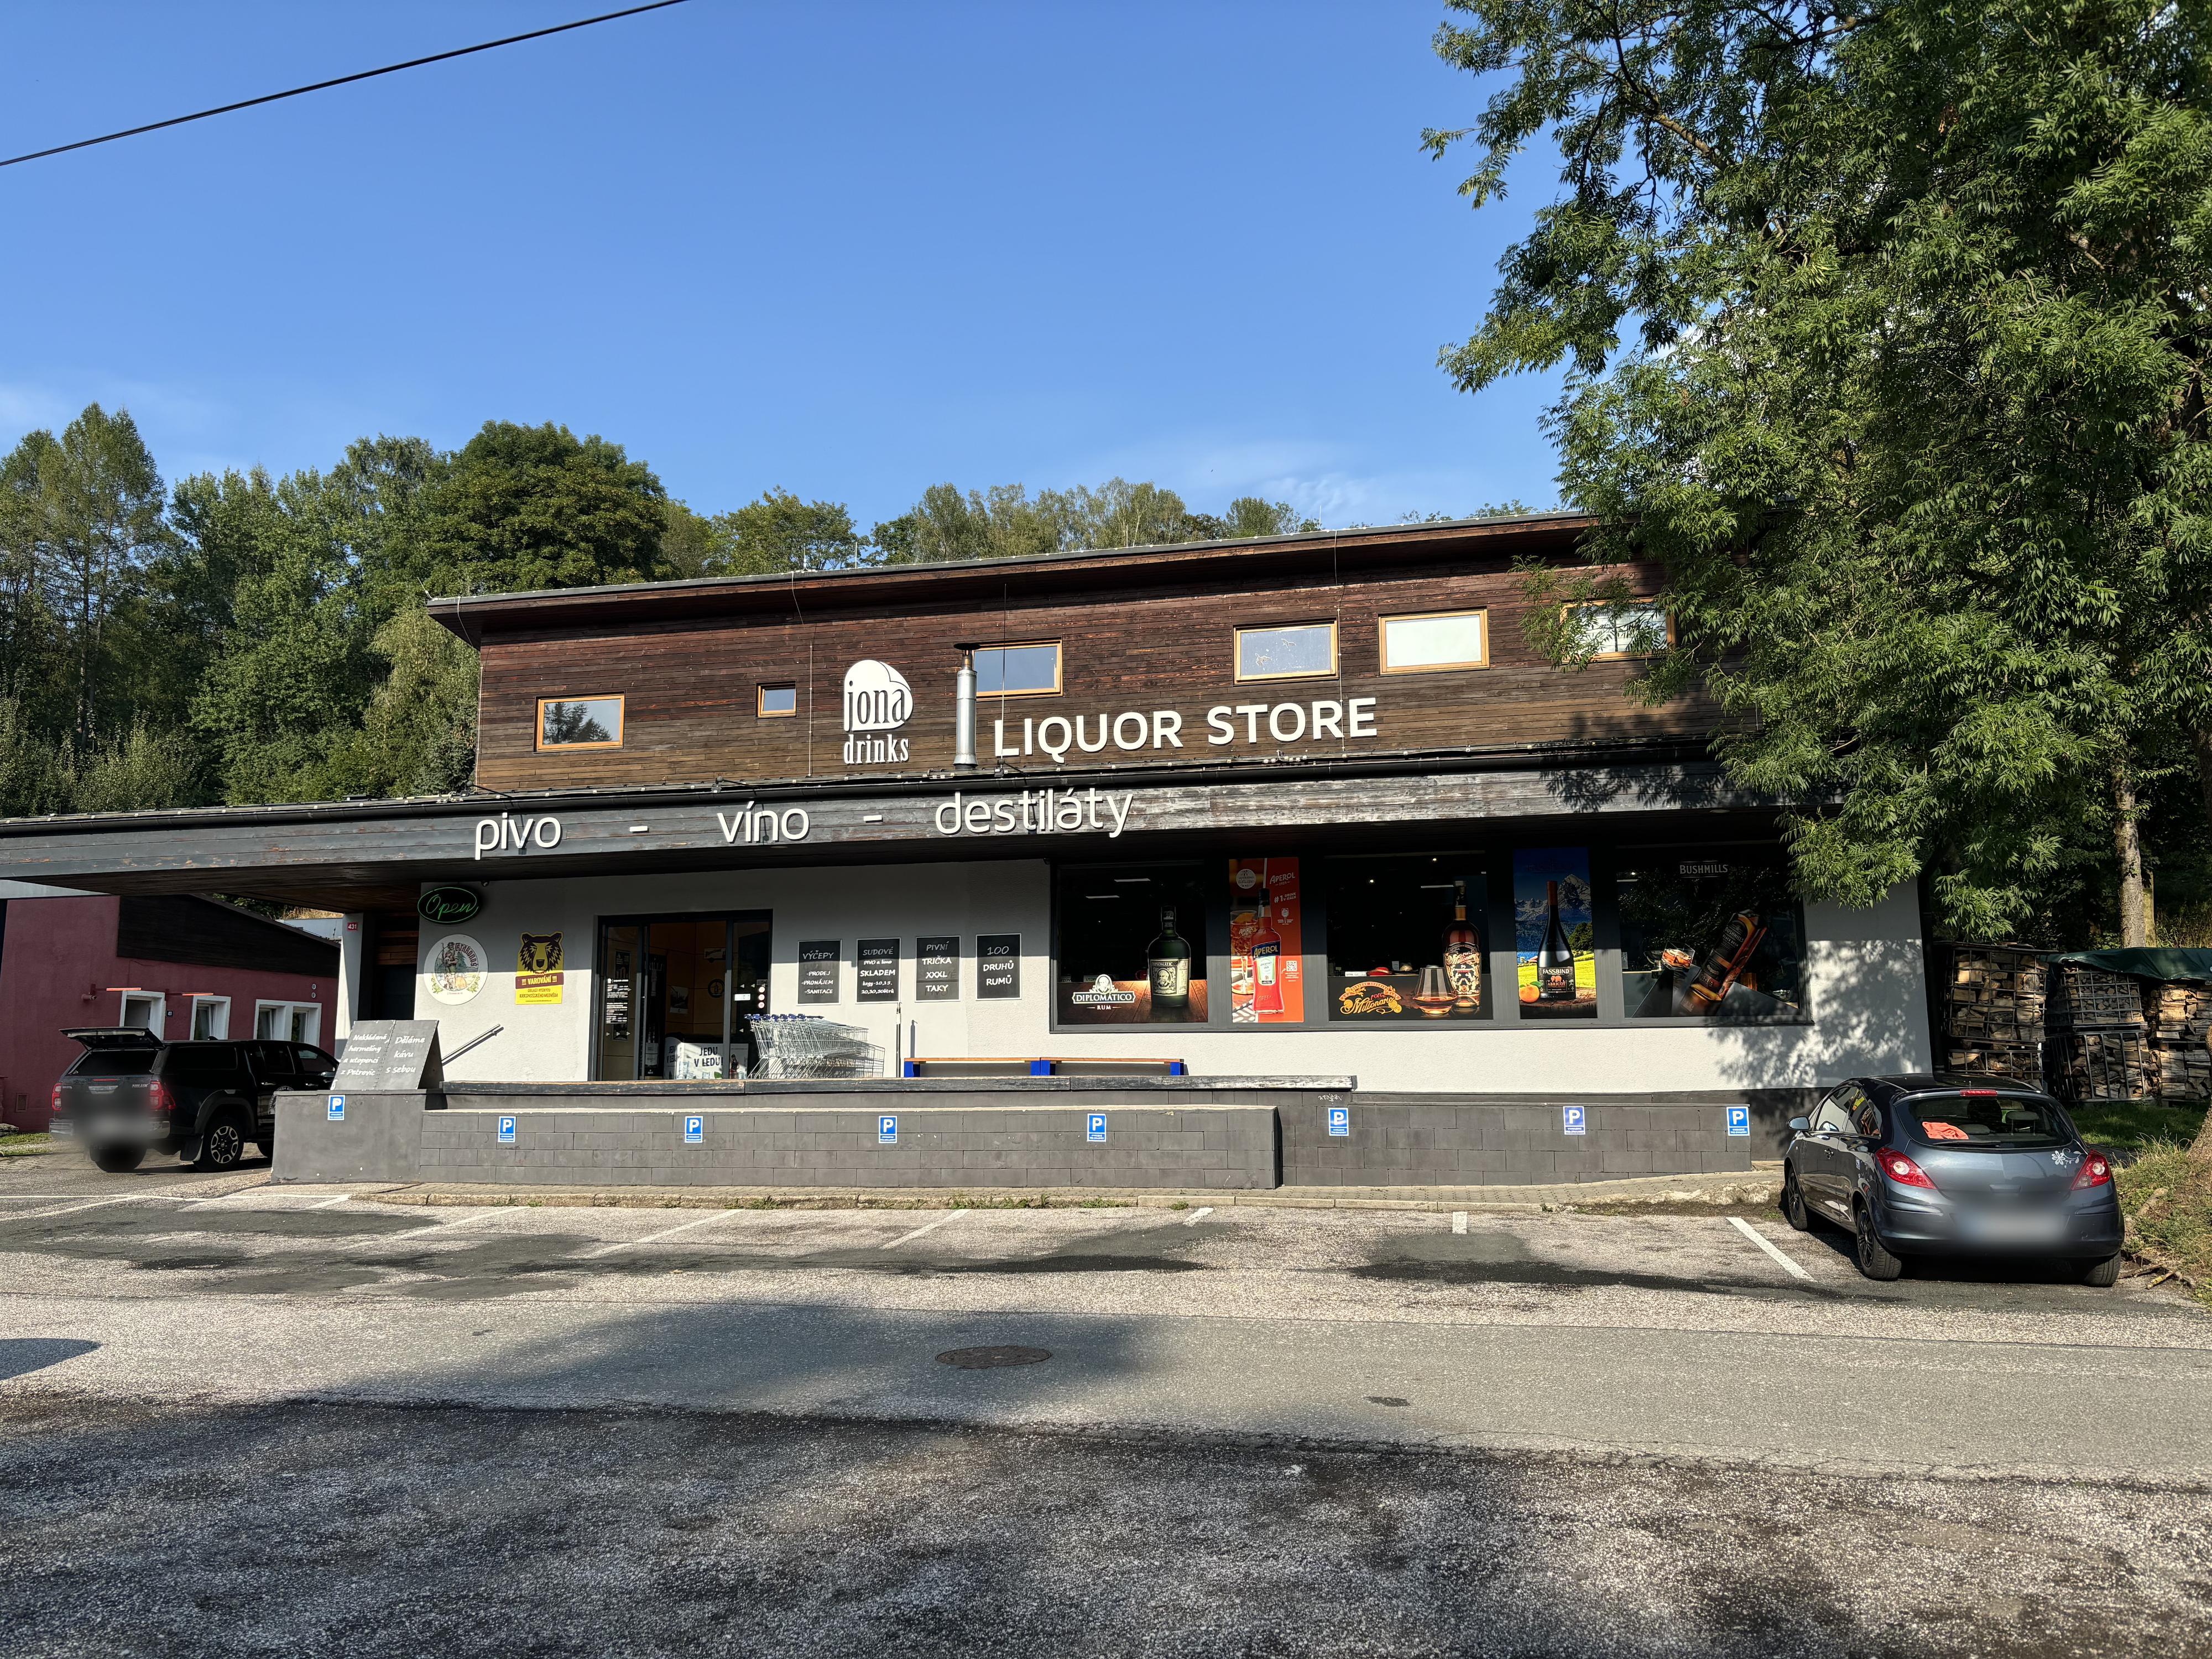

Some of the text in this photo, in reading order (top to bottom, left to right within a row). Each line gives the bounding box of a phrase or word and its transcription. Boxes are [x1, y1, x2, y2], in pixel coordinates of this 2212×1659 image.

[848, 681, 906, 731] jona
[994, 697, 1377, 763] LIQUOR STORE
[844, 734, 909, 764] drinks
[475, 812, 561, 860] pivo
[717, 801, 809, 843] víno
[936, 787, 1133, 838] destiláty
[1680, 864, 1729, 874] BUSHMILLS
[1270, 873, 1296, 884] APEROL
[426, 894, 474, 920] Open
[863, 947, 894, 956] SUDOVÉ
[926, 941, 950, 951] PIVNÍ
[987, 946, 1009, 955] 100
[1253, 945, 1279, 958] APEROL
[802, 950, 834, 960] VÝČEPY
[922, 955, 952, 965] TRIČKA
[983, 960, 1014, 972] DRUHŮ
[528, 975, 552, 985] VAROVÁNÍ
[986, 974, 1012, 986] RUMŮ
[1076, 993, 1132, 1001] DIPLOMÁTICO
[395, 1035, 425, 1044] Děláme
[348, 1045, 382, 1053] hermelíny
[699, 1046, 718, 1056] JEDU
[694, 1057, 723, 1067] V LEDU!
[392, 1065, 416, 1073] sebou
[332, 1098, 342, 1110] P
[1334, 1112, 1344, 1125] P
[1569, 1109, 1580, 1124] P
[1733, 1110, 1744, 1125] P
[503, 1119, 512, 1132] P
[689, 1119, 700, 1132] P
[883, 1119, 894, 1133] P
[1093, 1117, 1103, 1131] P
